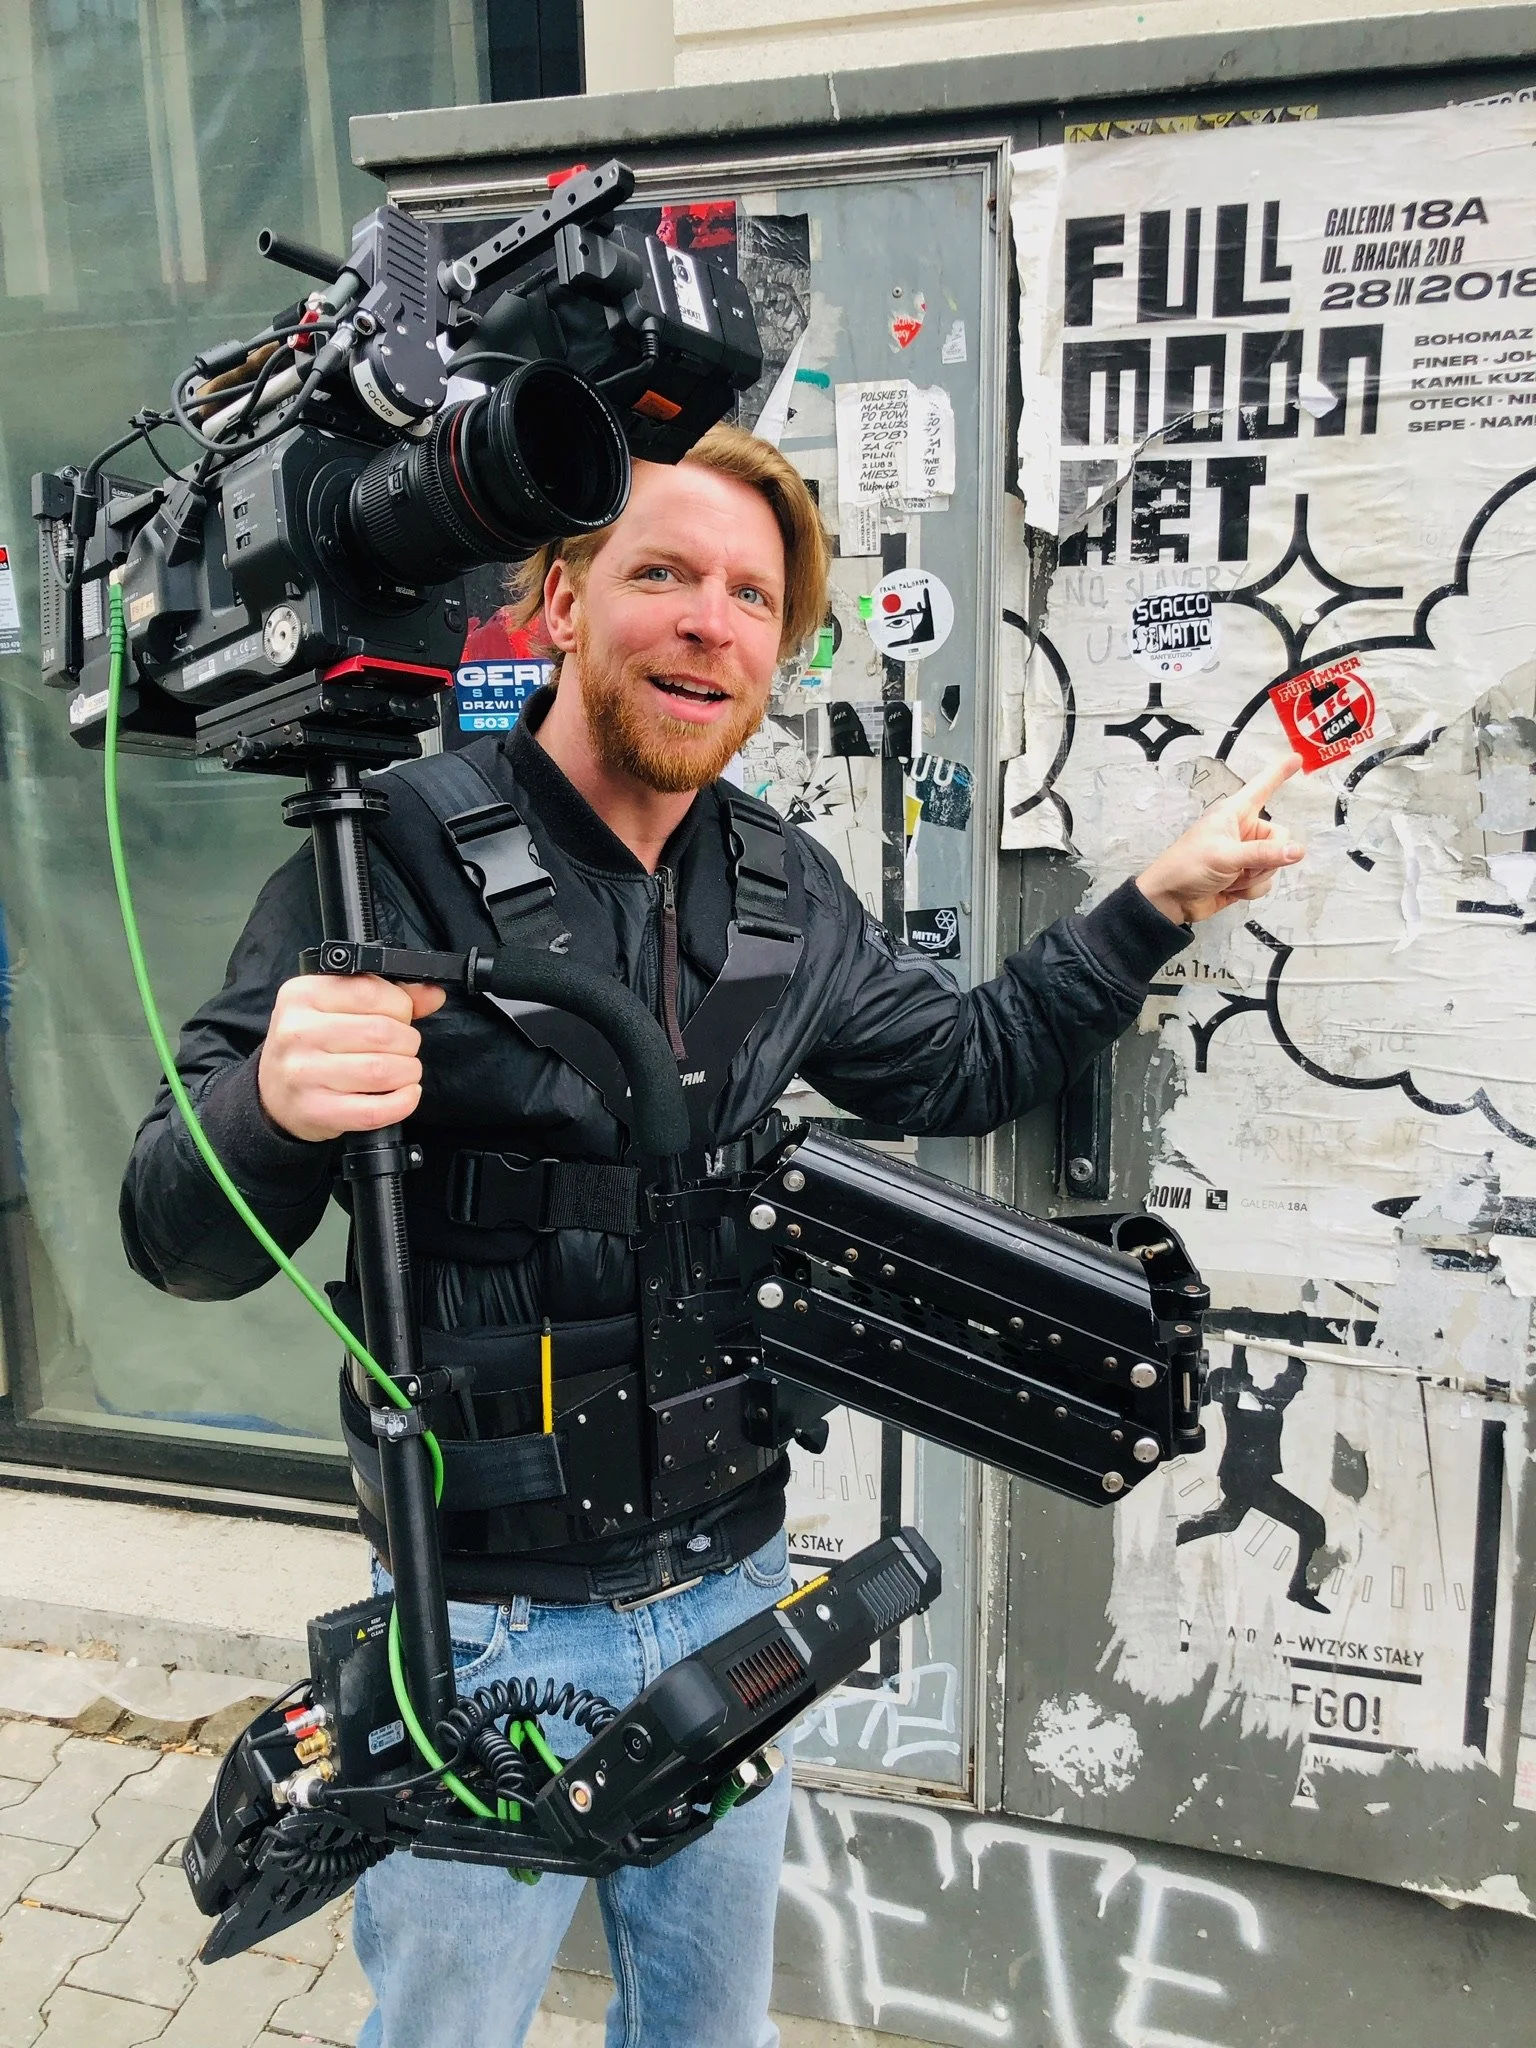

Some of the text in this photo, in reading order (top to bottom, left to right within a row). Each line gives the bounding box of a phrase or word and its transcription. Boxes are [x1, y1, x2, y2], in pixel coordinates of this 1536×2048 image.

[1324, 196, 1489, 238] GALERIA 18A
[1064, 200, 1292, 328] FULL
[1321, 246, 1346, 275] UL.
[1351, 239, 1423, 273] BRACKA
[1320, 279, 1392, 312] 28
[1415, 267, 1536, 305] 2018
[1414, 328, 1534, 347] BOHOMAZ
[1412, 354, 1479, 369] FINER
[1411, 371, 1536, 390] KAMIL KUZ
[364, 382, 394, 417] FOCUS
[861, 390, 897, 402] POLSKIE
[1409, 395, 1493, 411] OTECKI
[861, 412, 877, 422] PO
[1408, 414, 1536, 433] SEPE NAM
[870, 461, 885, 469] LUB
[859, 481, 884, 494] Telefon
[1065, 570, 1108, 609] NO
[1135, 594, 1210, 622] SCACCO
[1157, 619, 1211, 649] MATTO
[1279, 656, 1361, 702] FÜR IMMER
[462, 700, 514, 710] DRZWI
[473, 717, 509, 729] 503
[1323, 711, 1354, 741] KÖLN
[1319, 727, 1375, 760] NUR-DU
[912, 930, 941, 942] MITH
[1240, 1198, 1308, 1212] GALERIA 18A
[801, 1534, 844, 1554] STAŁY
[1299, 1635, 1425, 1668] WYZYSK STAŁY
